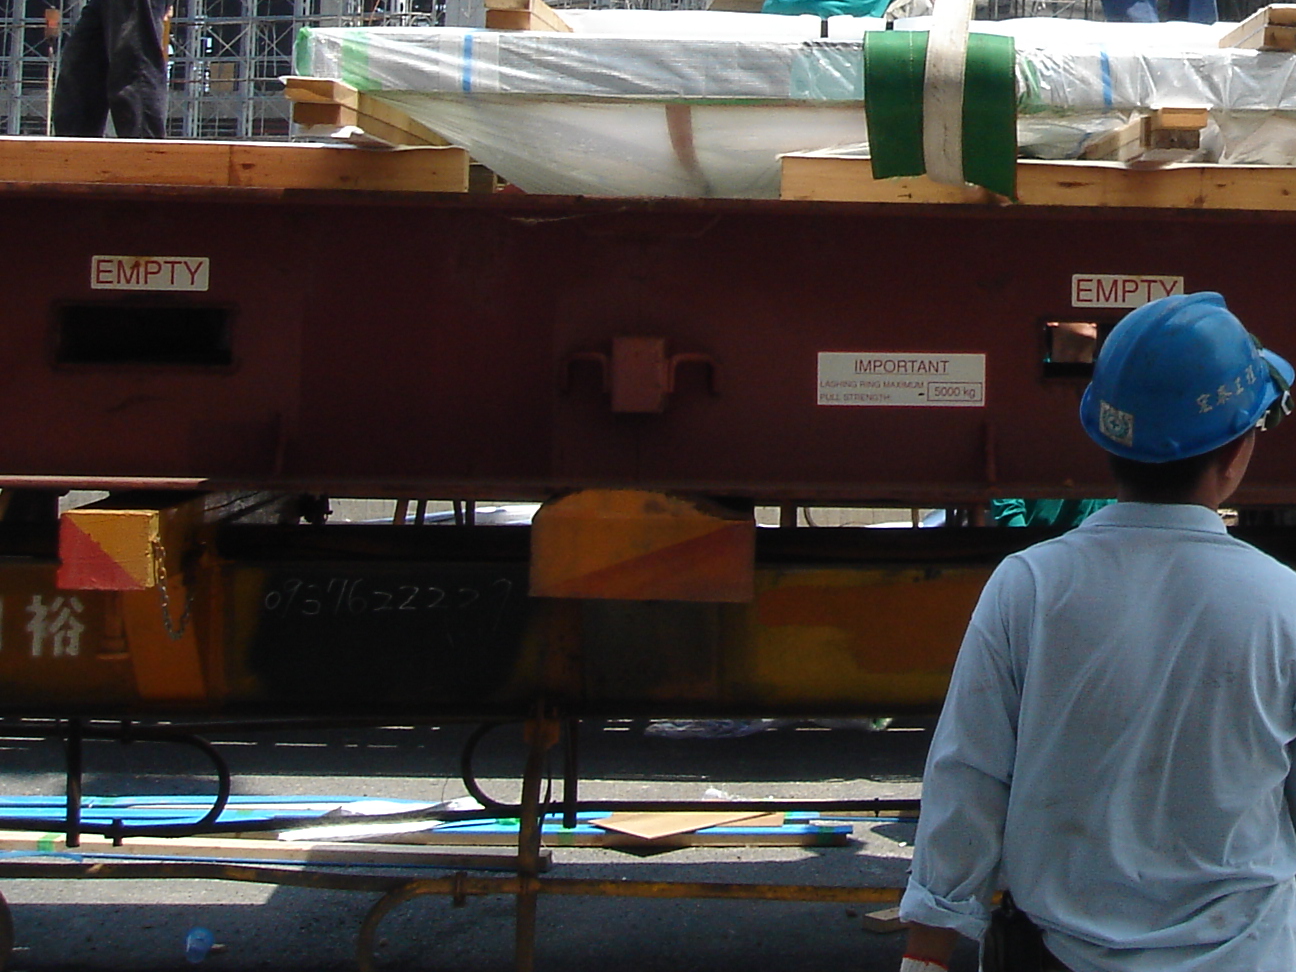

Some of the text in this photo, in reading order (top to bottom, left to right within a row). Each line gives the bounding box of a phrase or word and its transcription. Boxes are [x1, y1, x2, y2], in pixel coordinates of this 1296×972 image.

[96, 259, 204, 285] EMPTY
[1076, 278, 1178, 303] EMPTY
[854, 359, 950, 374] IMPORTANT
[819, 380, 924, 389] LASHING RING MAXIMUM
[819, 393, 842, 402] PULL
[934, 386, 976, 399] 5000 kg
[0, 593, 85, 657] 裕
